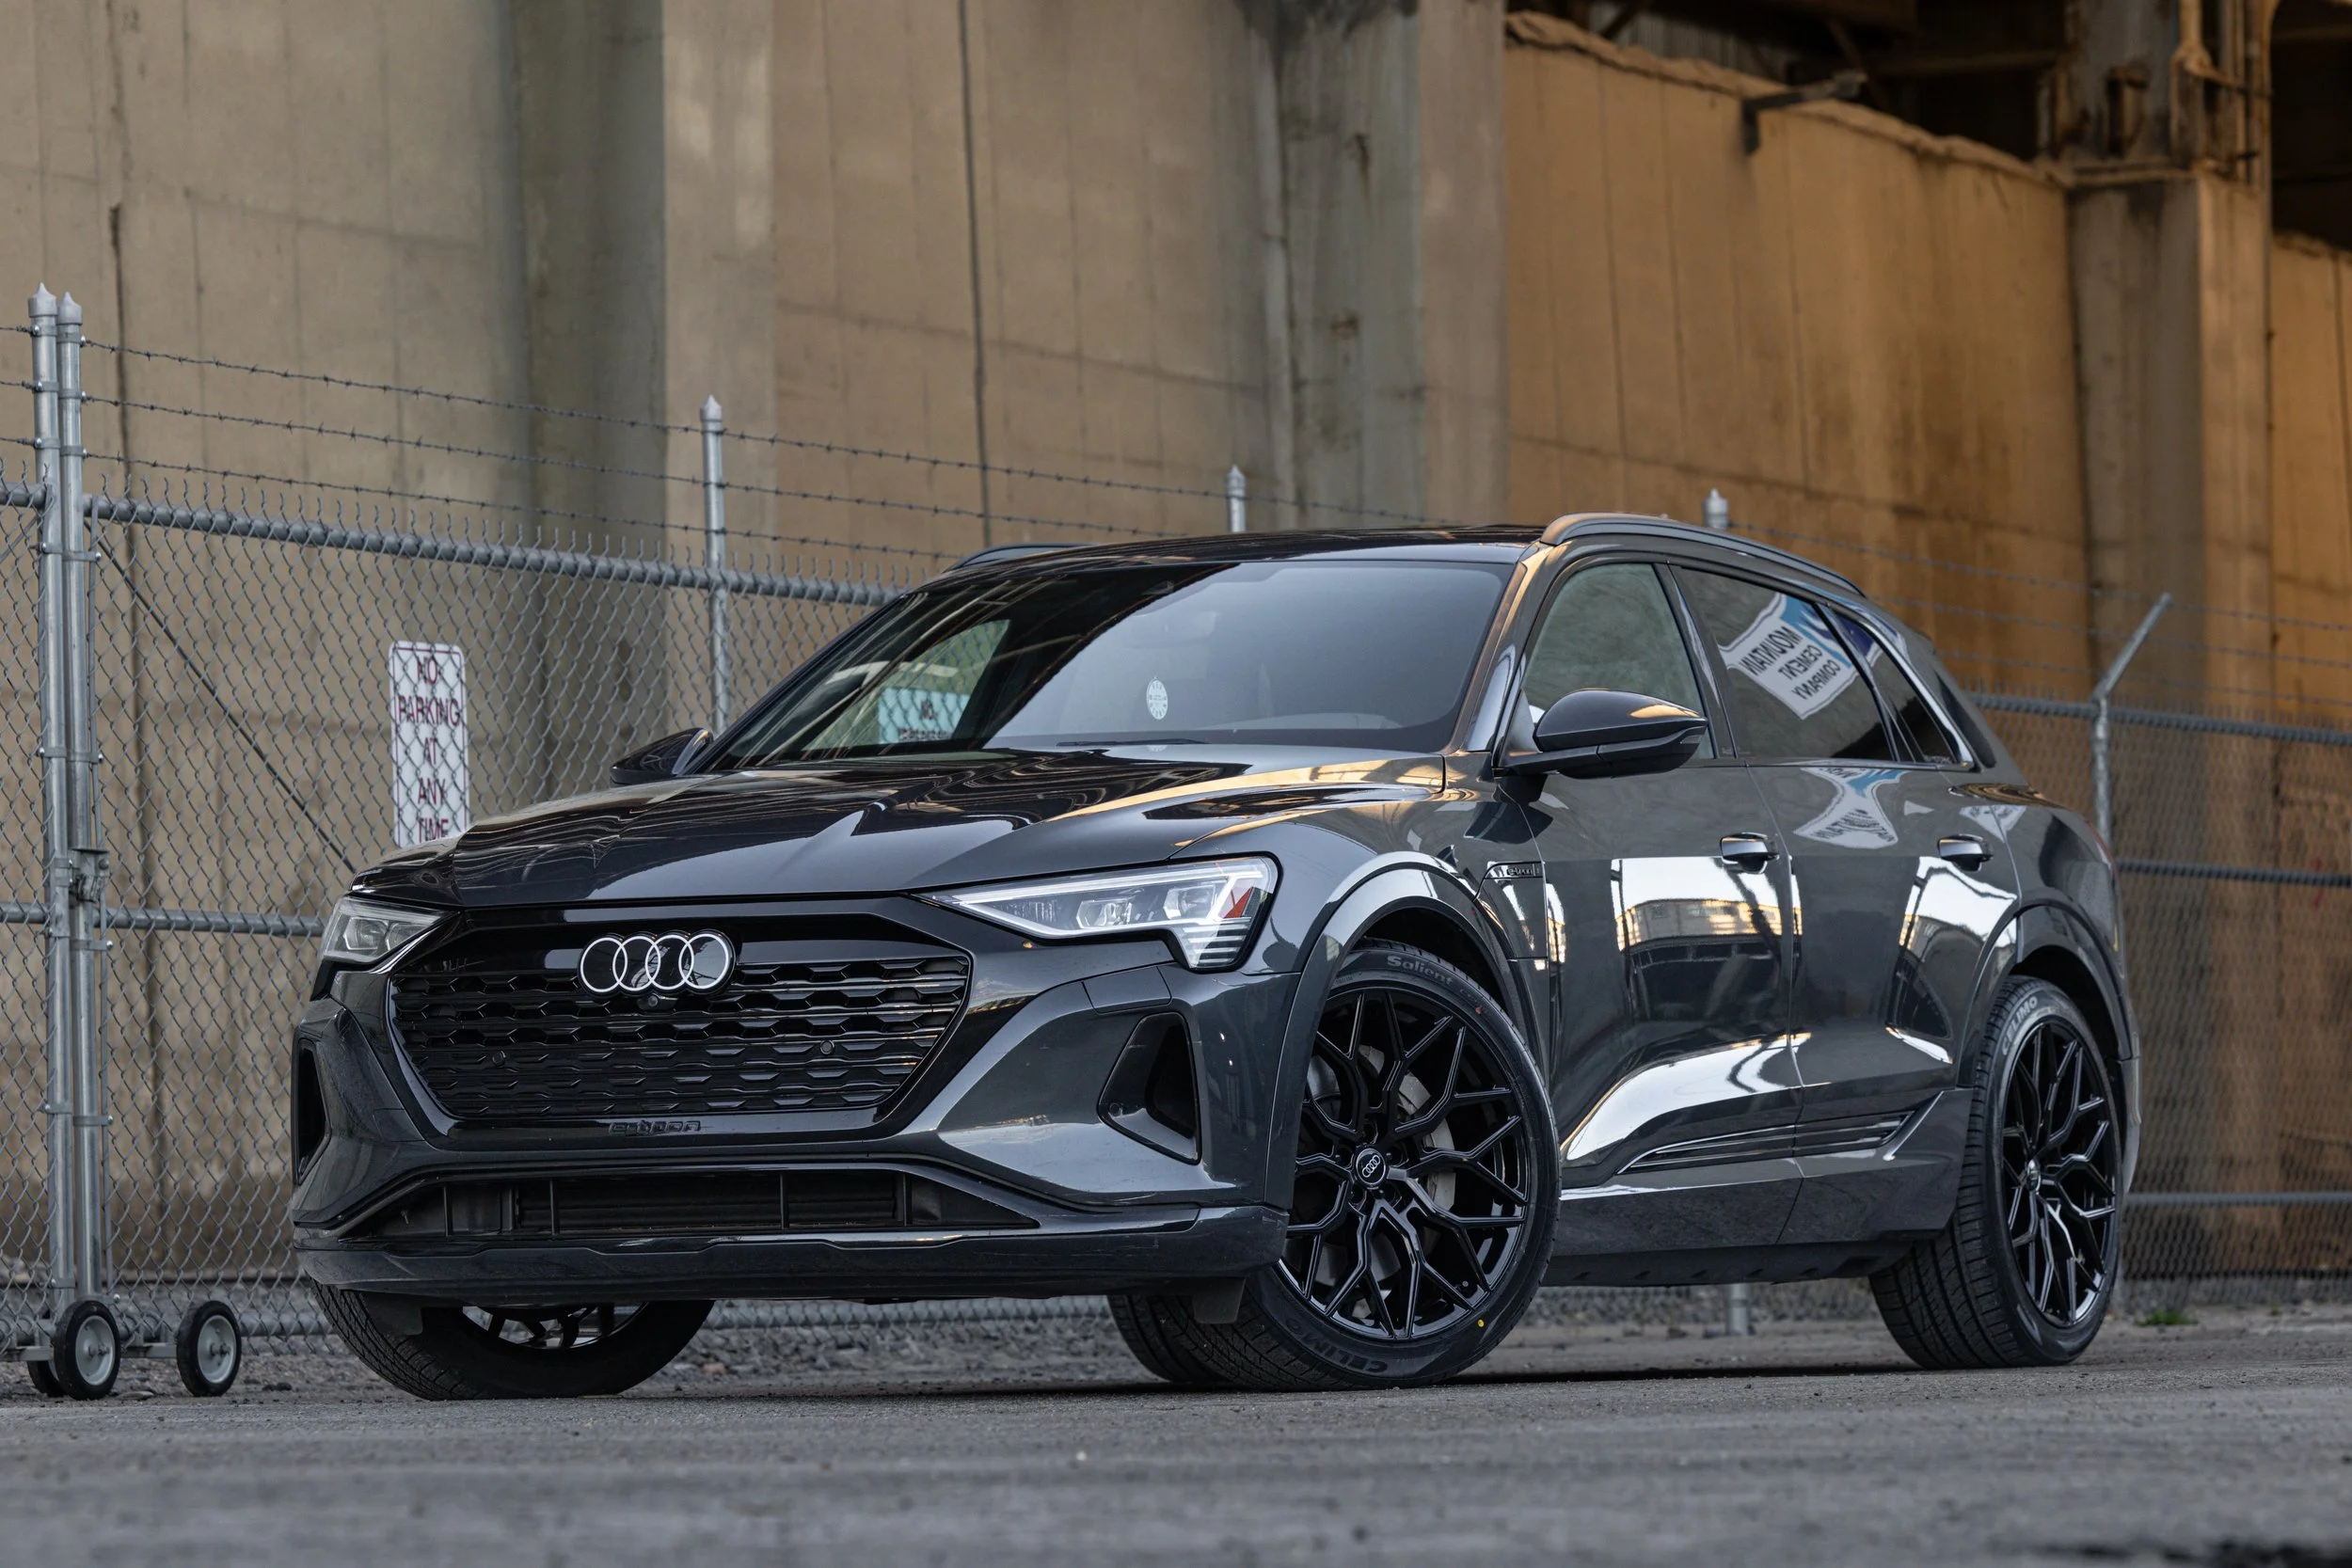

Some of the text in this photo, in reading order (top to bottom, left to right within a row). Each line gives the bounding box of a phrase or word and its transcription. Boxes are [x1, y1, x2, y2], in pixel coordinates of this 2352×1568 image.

[417, 656, 438, 685] NO
[399, 696, 461, 727] PARKING
[423, 736, 437, 765] AT
[418, 777, 447, 806] ANY
[1387, 955, 1454, 986] Salient
[2002, 996, 2038, 1055] CELIMO
